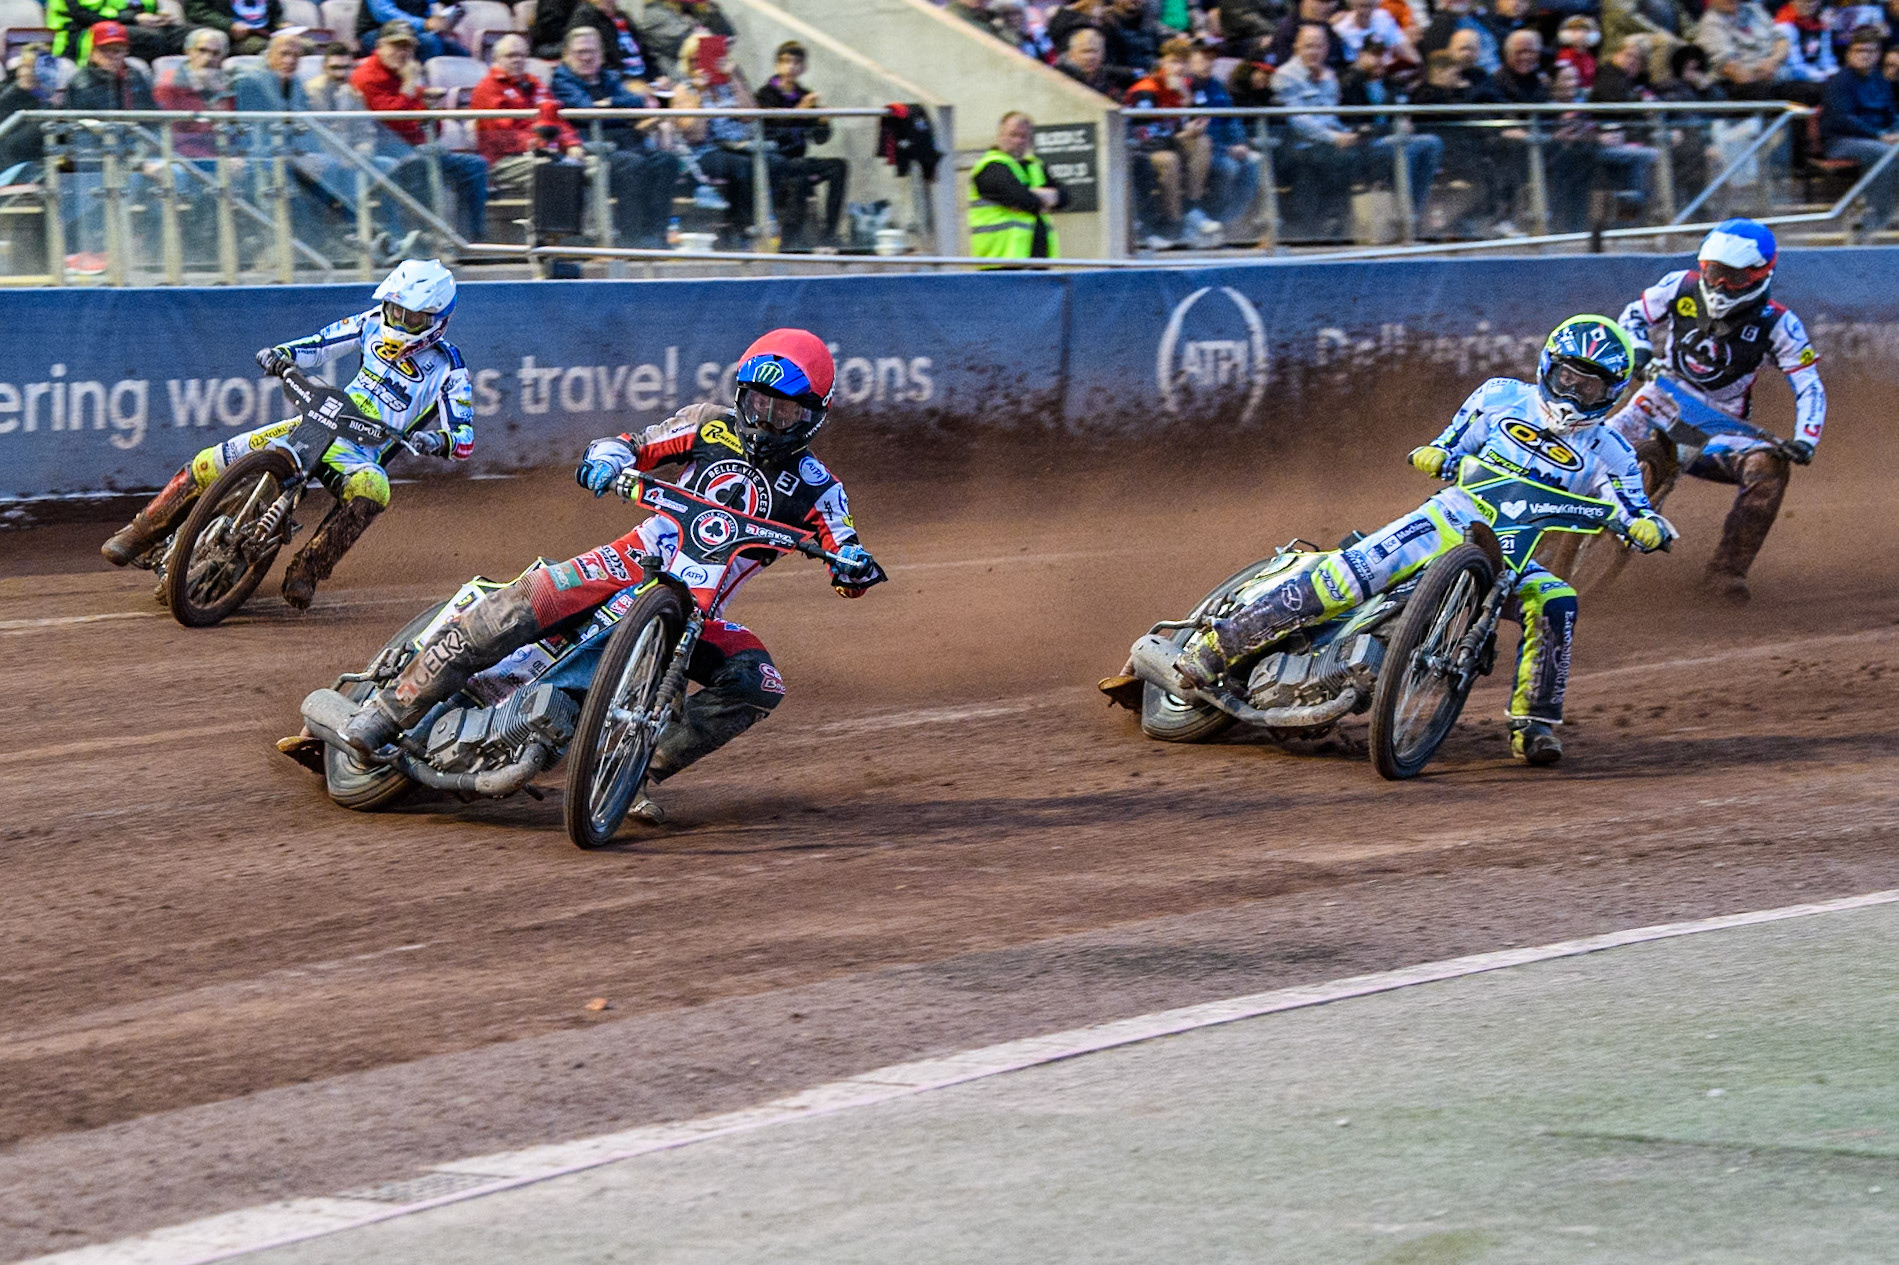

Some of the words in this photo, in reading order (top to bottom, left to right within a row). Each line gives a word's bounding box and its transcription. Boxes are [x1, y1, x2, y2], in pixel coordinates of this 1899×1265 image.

[307, 410, 338, 430] BETARD
[805, 461, 825, 480] ATPI
[707, 464, 738, 479] BELLE
[742, 467, 760, 484] VUE
[757, 486, 768, 513] ACES
[778, 472, 798, 493] 3
[697, 512, 715, 522] BELLE
[1501, 539, 1515, 549] 21
[685, 571, 704, 581] ATPI
